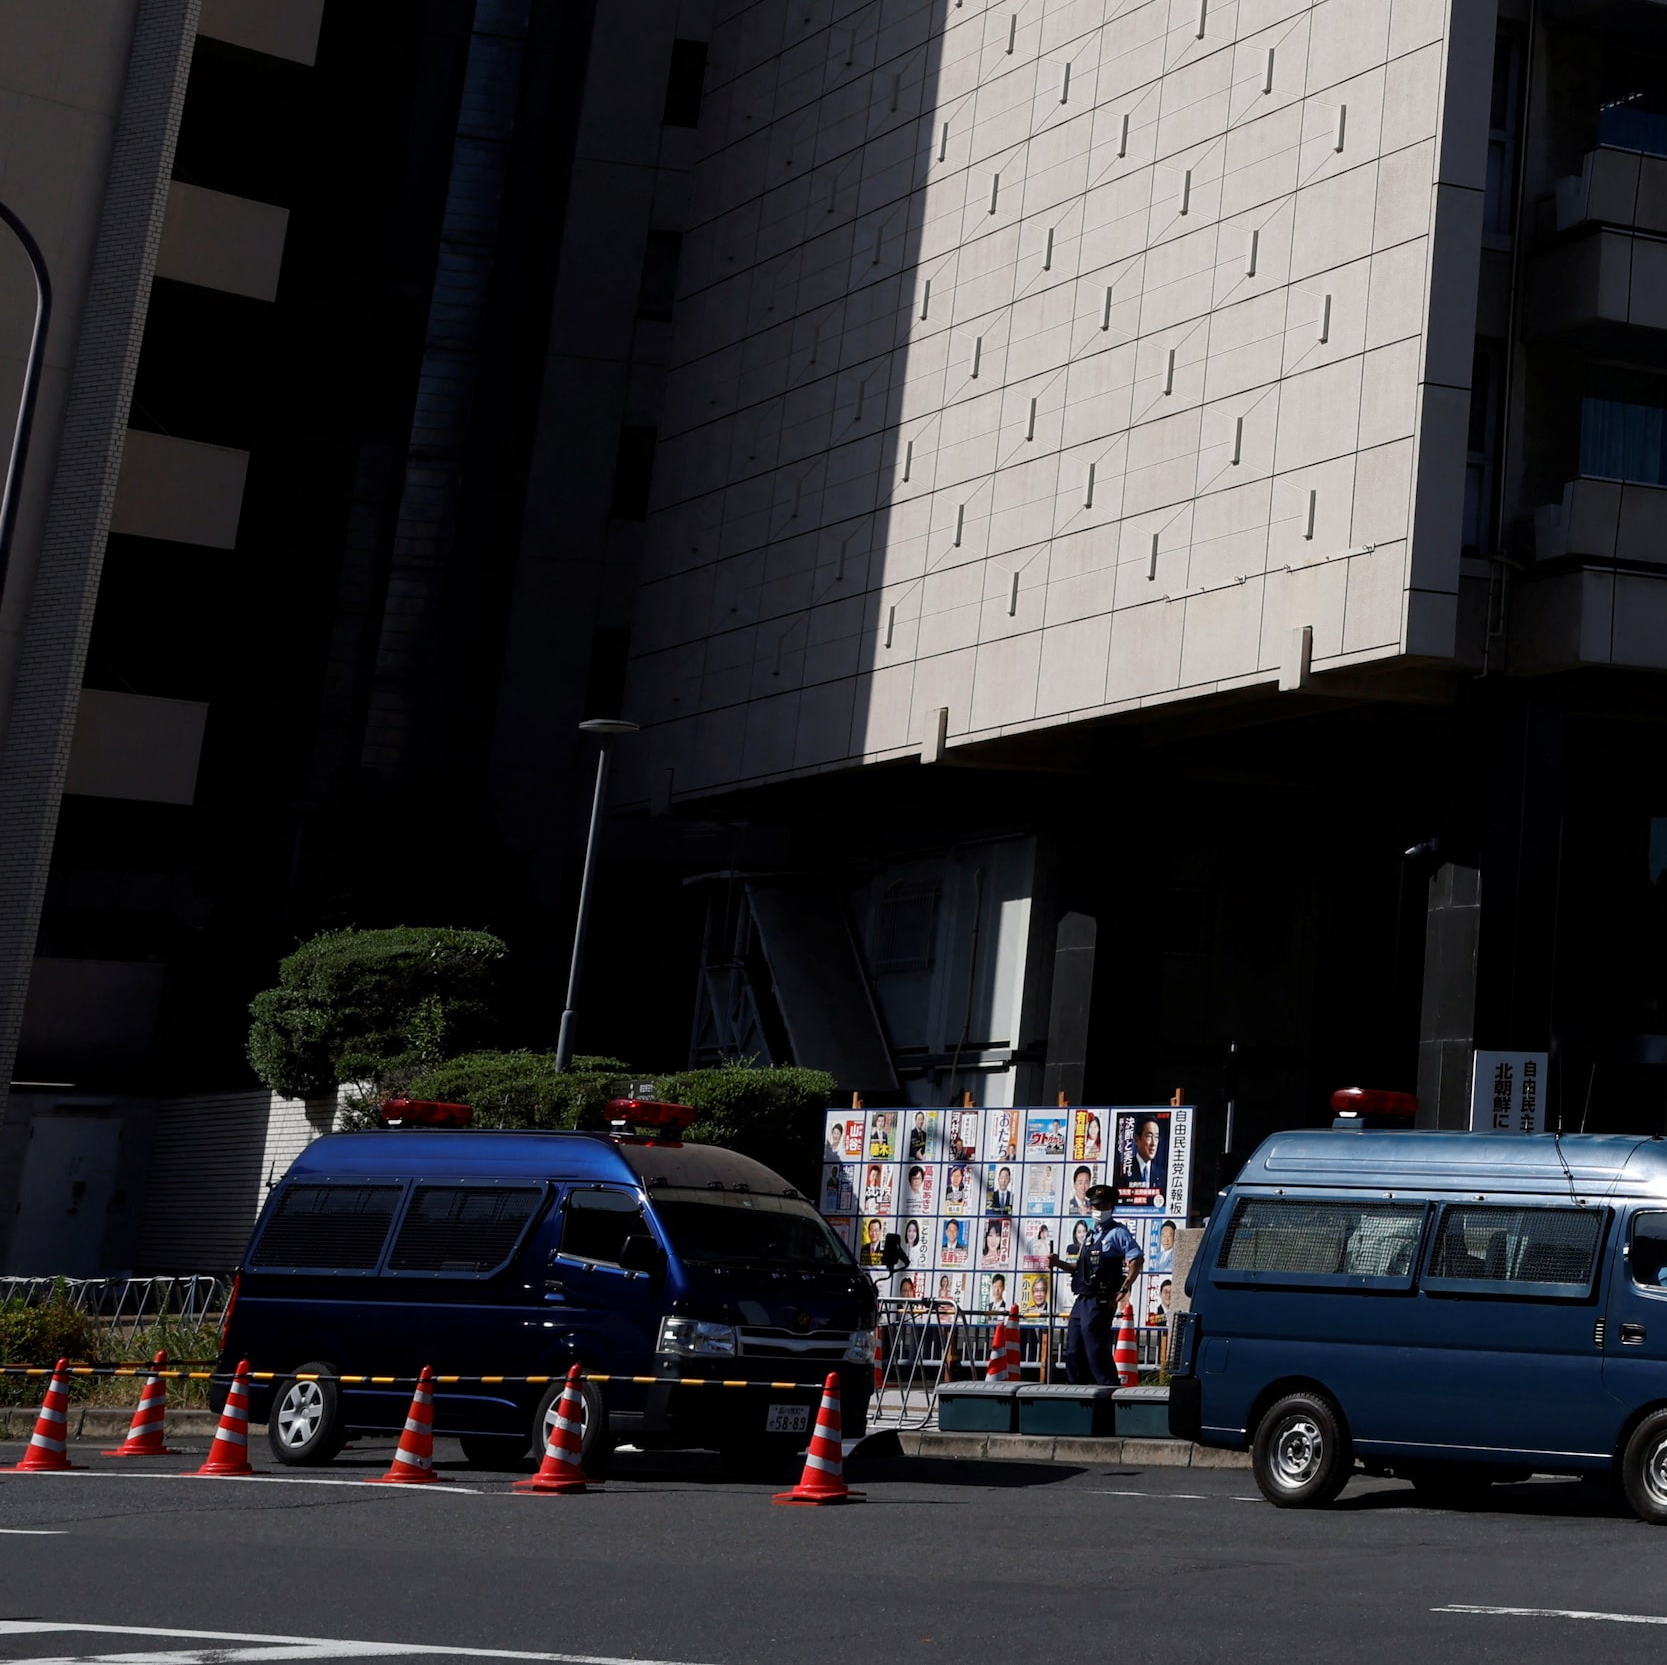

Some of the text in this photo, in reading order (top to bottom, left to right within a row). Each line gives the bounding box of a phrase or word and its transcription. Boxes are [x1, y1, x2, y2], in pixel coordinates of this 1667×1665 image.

[1493, 1063, 1513, 1129] 北朝鮮に
[1520, 1060, 1537, 1133] 自由民主
[1169, 1110, 1187, 1215] 自由民主党広報板
